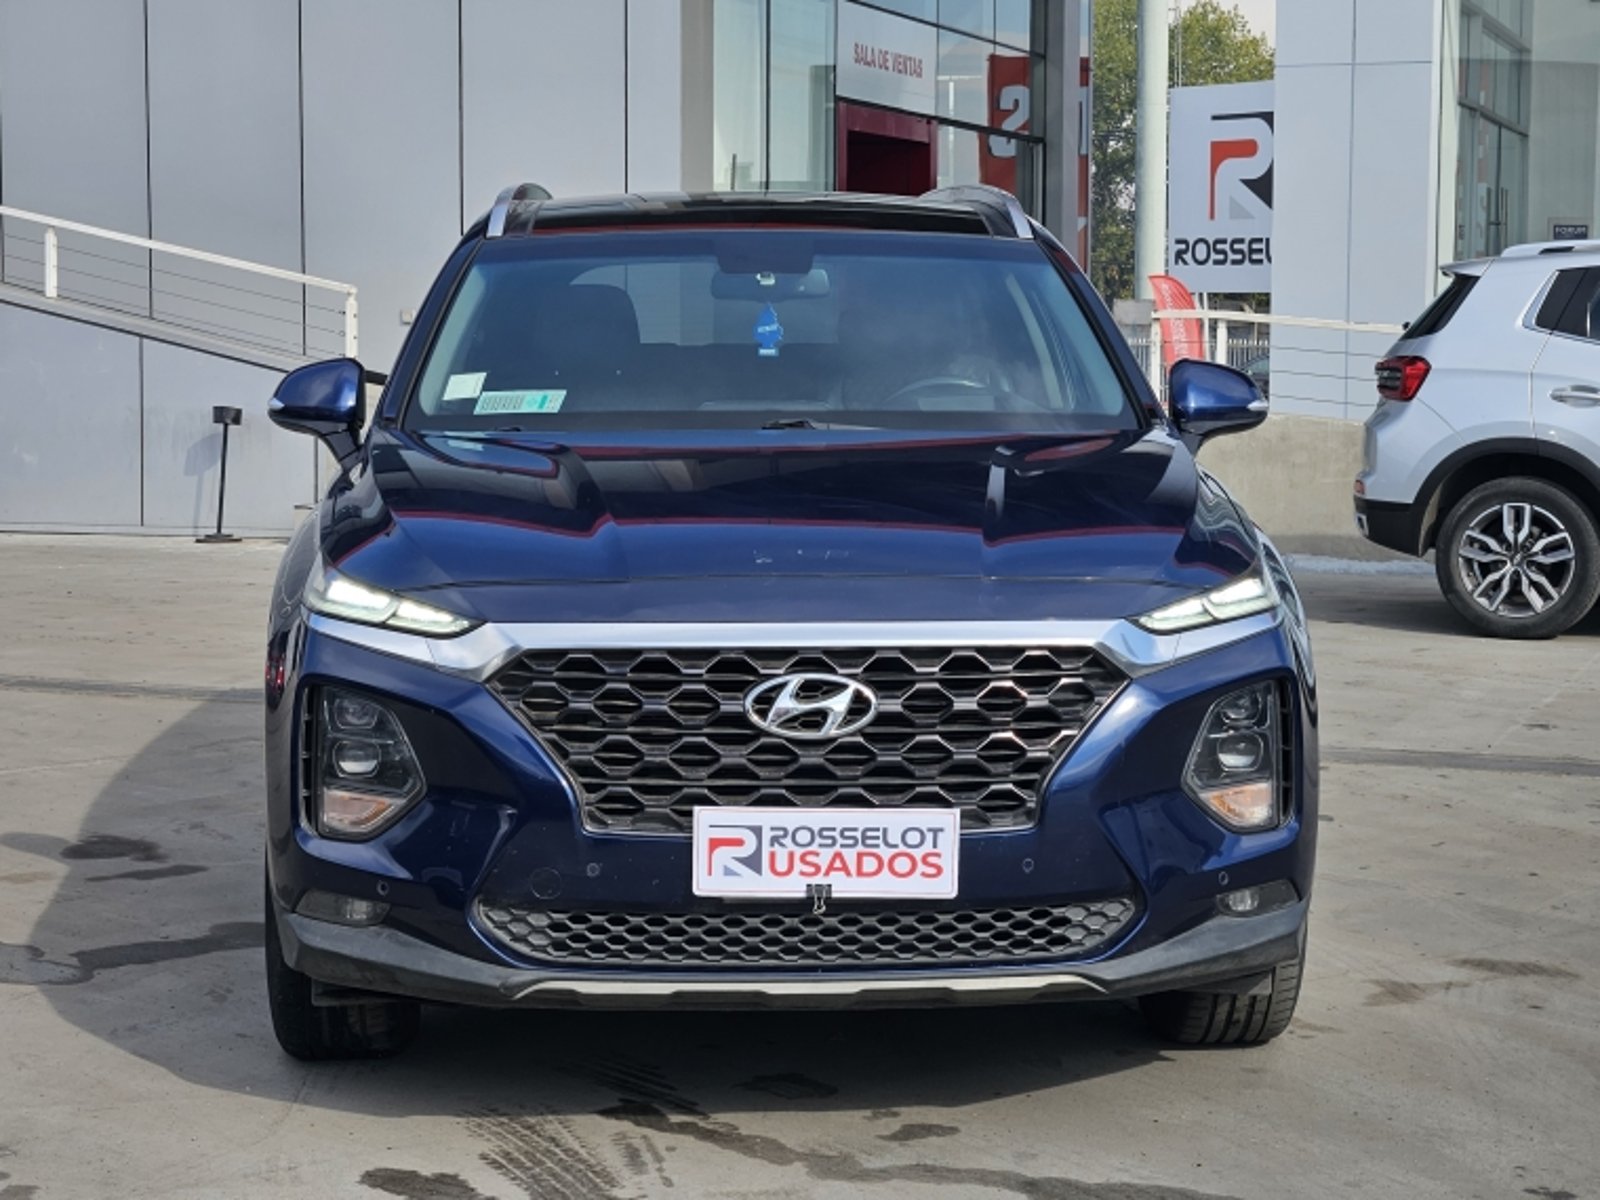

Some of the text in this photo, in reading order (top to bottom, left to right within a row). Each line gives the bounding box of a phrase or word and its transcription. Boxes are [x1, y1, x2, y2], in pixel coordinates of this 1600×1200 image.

[853, 42, 923, 79] SALA DE VENTAS
[769, 825, 945, 850] ROSSELOT
[768, 850, 944, 879] USADOS
